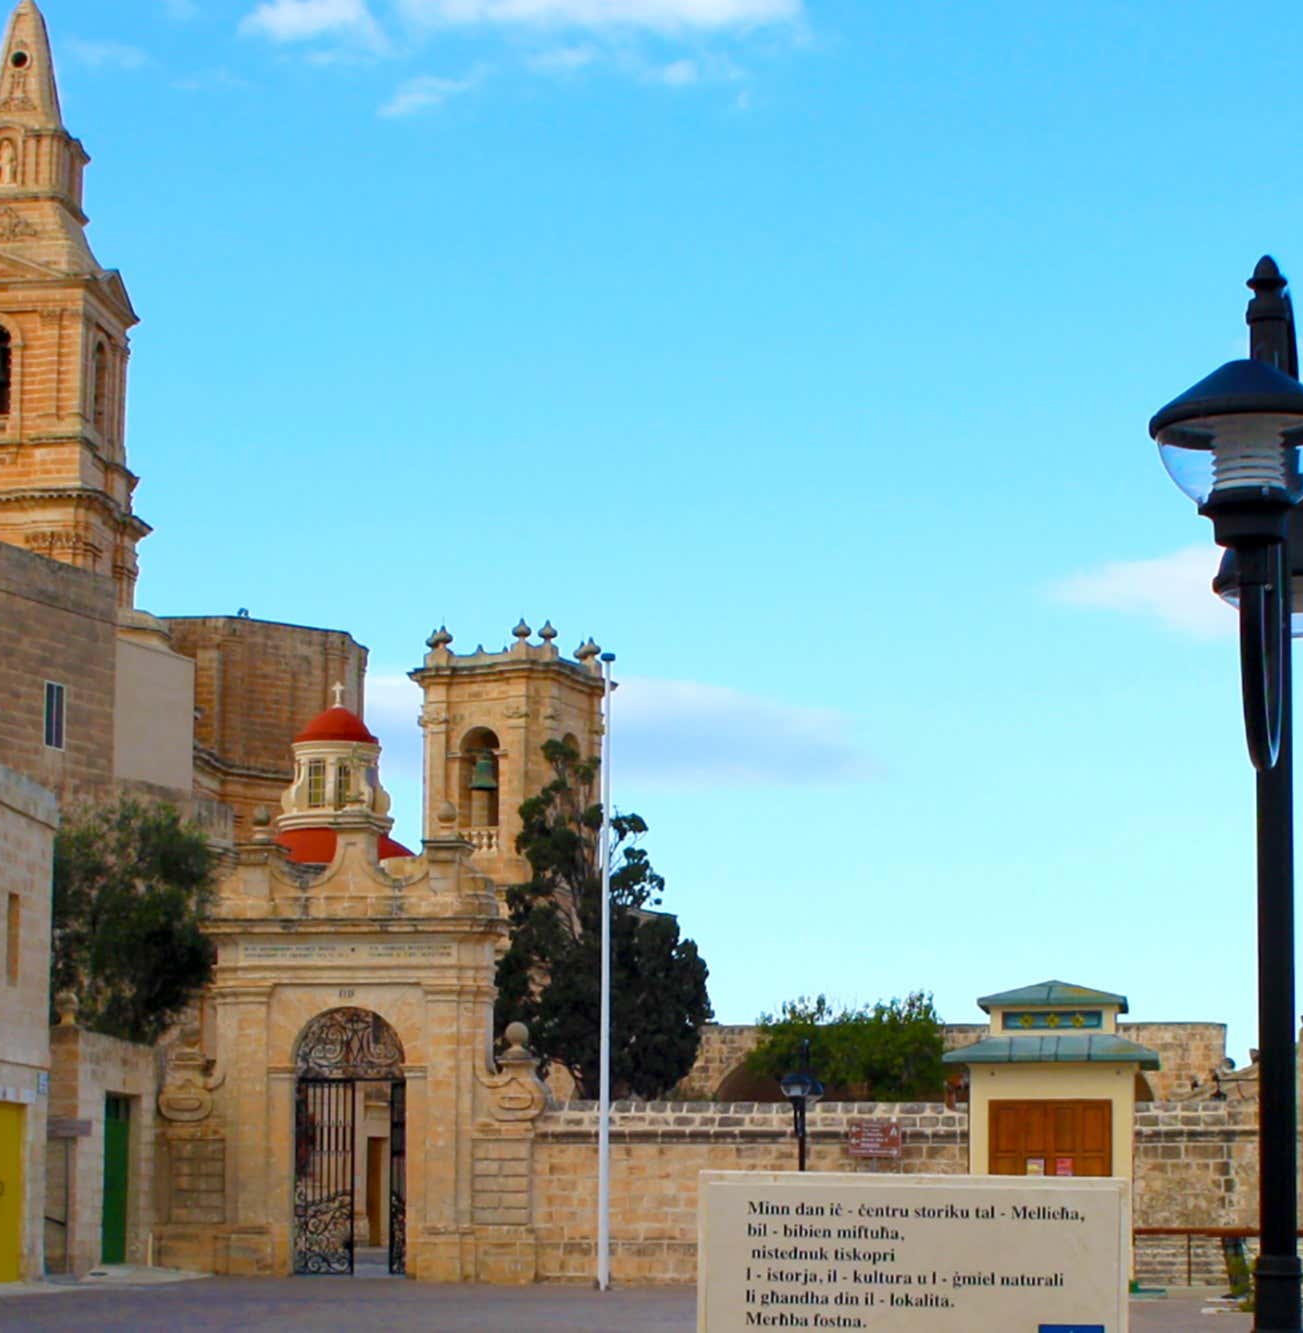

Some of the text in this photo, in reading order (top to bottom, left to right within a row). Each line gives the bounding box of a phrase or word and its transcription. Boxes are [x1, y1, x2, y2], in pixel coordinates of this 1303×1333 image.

[748, 1200, 790, 1216] Minn
[794, 1202, 825, 1217] dan
[913, 1203, 970, 1219] storiku
[974, 1205, 995, 1220] tal
[747, 1222, 767, 1237] bil
[783, 1223, 832, 1239] bibien
[751, 1244, 895, 1266] nistednuk tiskopri
[766, 1267, 824, 1286] istorja,
[827, 1268, 837, 1283] il
[852, 1269, 913, 1285] kultura
[917, 1274, 927, 1285] u
[1000, 1272, 1064, 1287] naturali
[745, 1288, 756, 1304] li
[833, 1290, 860, 1306] din
[864, 1291, 875, 1307] il
[813, 1312, 867, 1329] fostna.
